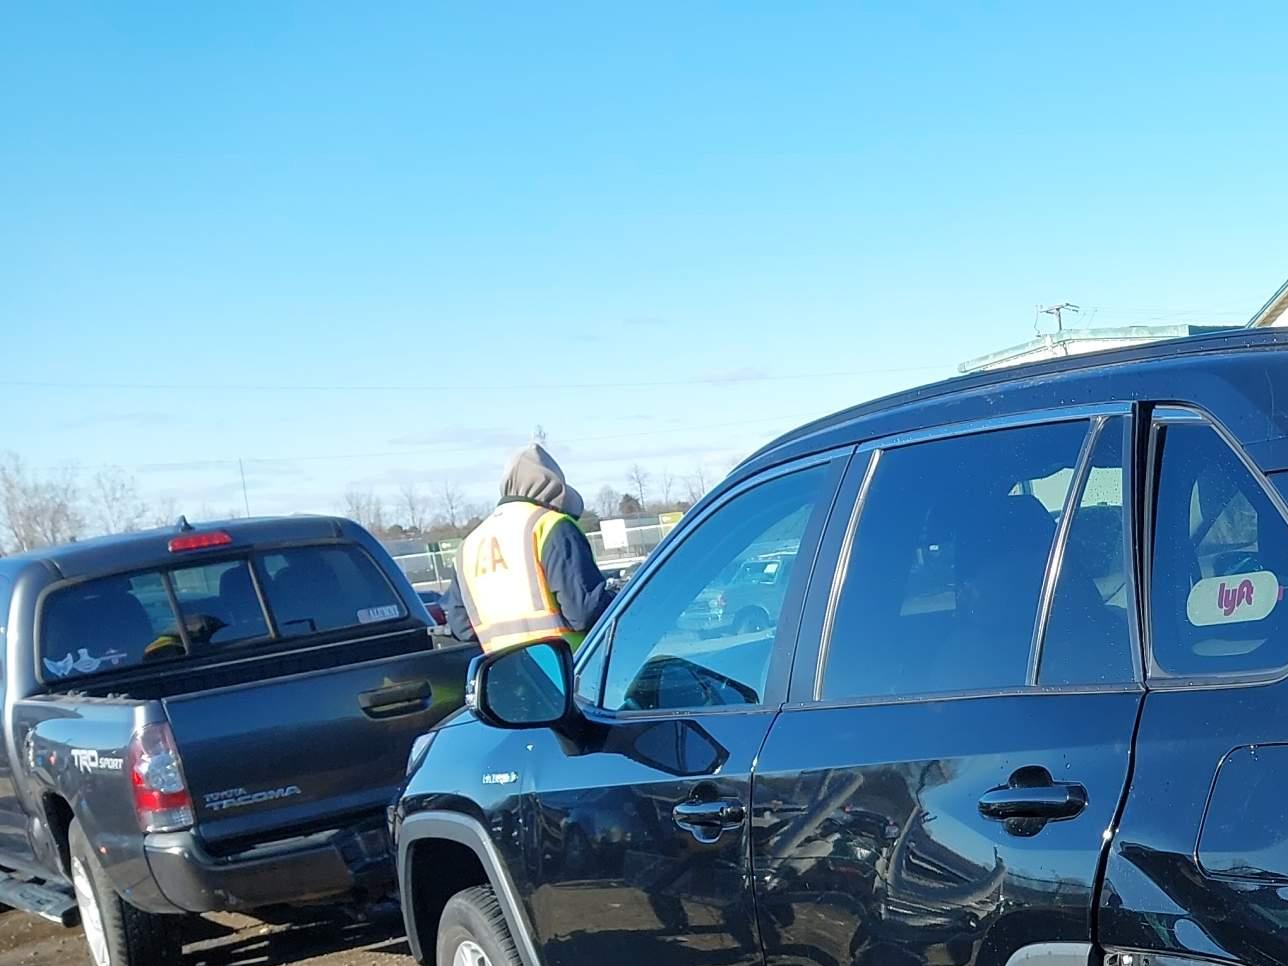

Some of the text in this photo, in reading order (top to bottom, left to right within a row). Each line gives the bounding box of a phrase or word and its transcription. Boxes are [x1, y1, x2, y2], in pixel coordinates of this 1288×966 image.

[1217, 579, 1254, 617] lyft
[71, 749, 124, 774] TRD SPORT
[203, 788, 247, 802] TOYOTA
[205, 786, 302, 811] TACOMA
